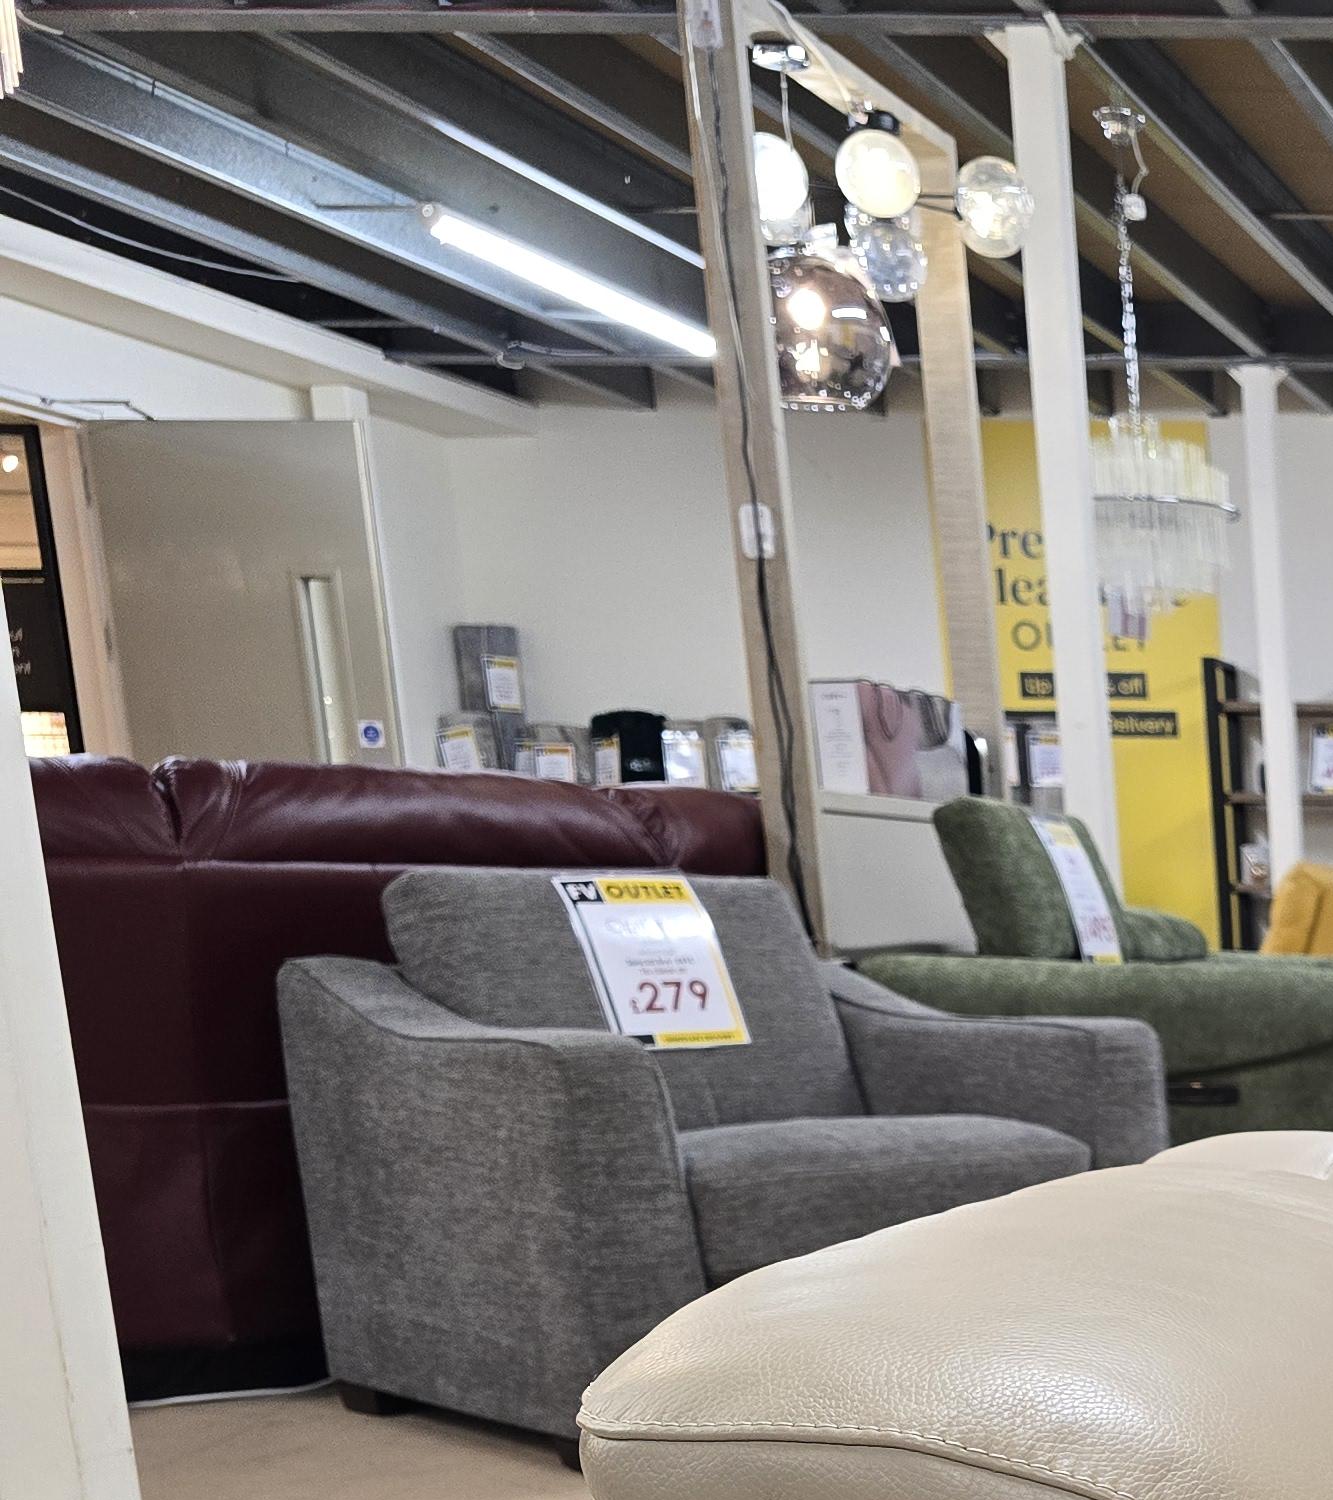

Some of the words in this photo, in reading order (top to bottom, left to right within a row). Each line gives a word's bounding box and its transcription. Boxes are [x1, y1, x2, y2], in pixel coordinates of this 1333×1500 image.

[1111, 715, 1174, 736] elivery
[566, 882, 599, 902] FV
[606, 885, 684, 899] OUTLET
